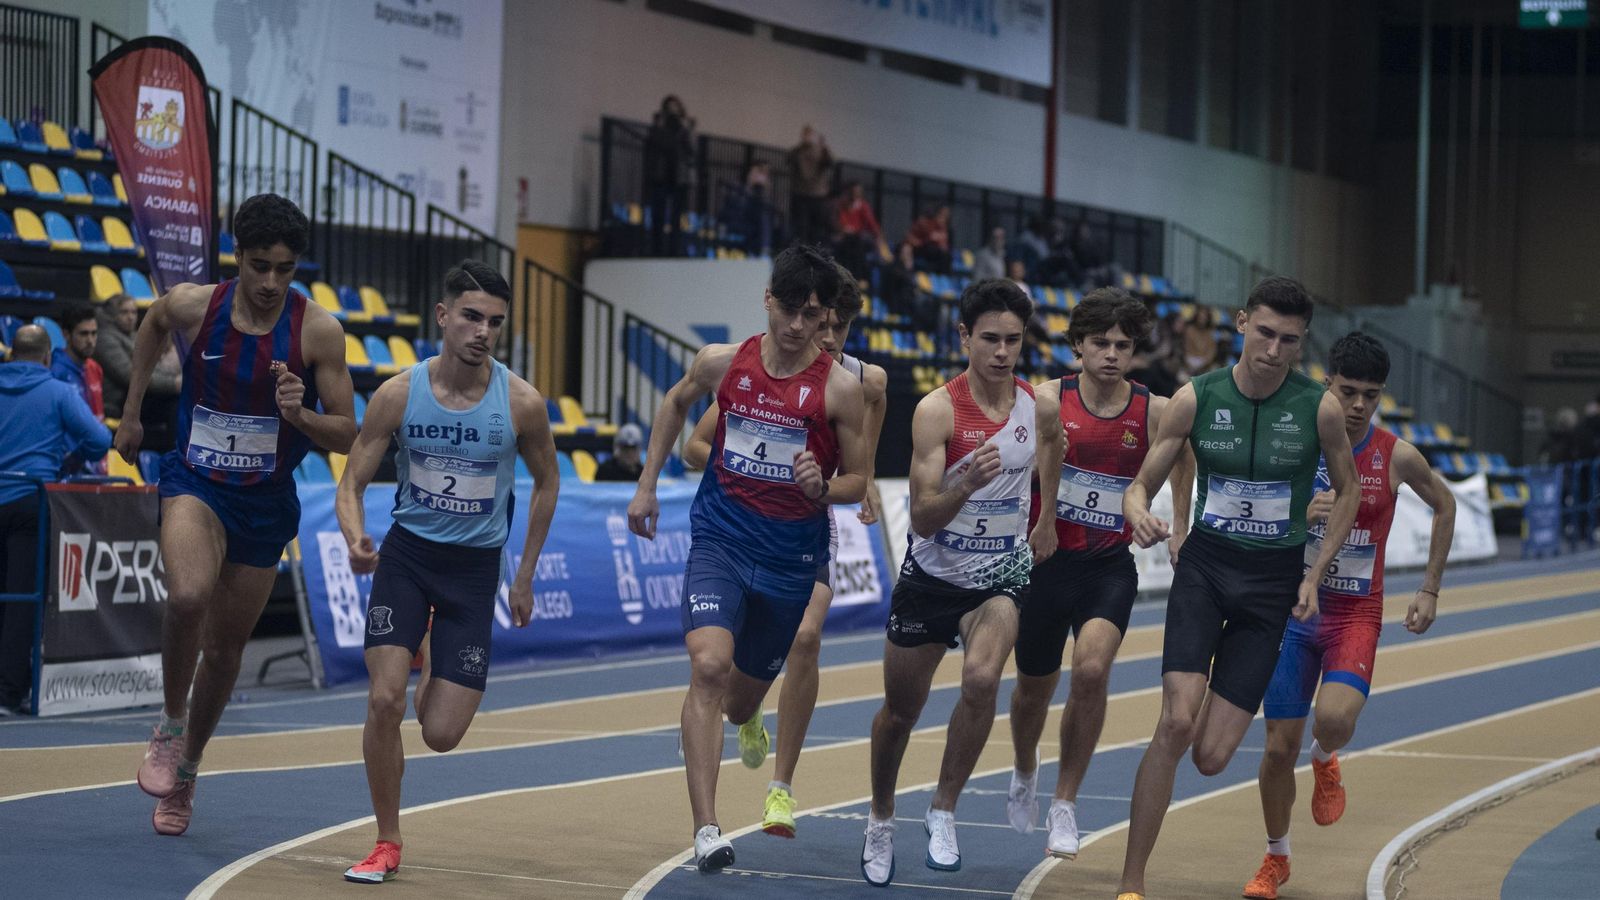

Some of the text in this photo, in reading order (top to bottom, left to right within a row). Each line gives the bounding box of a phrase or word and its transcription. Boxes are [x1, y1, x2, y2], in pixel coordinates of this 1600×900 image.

[731, 402, 804, 427] A.D. MARATHON
[408, 421, 480, 445] nerja
[226, 434, 236, 452] 1
[753, 441, 768, 460] 4
[442, 476, 457, 496] 2
[1085, 491, 1099, 508] 8
[1240, 501, 1253, 518] 3
[974, 518, 988, 536] 5
[1321, 576, 1361, 592] oma
[692, 602, 719, 612] ADM
